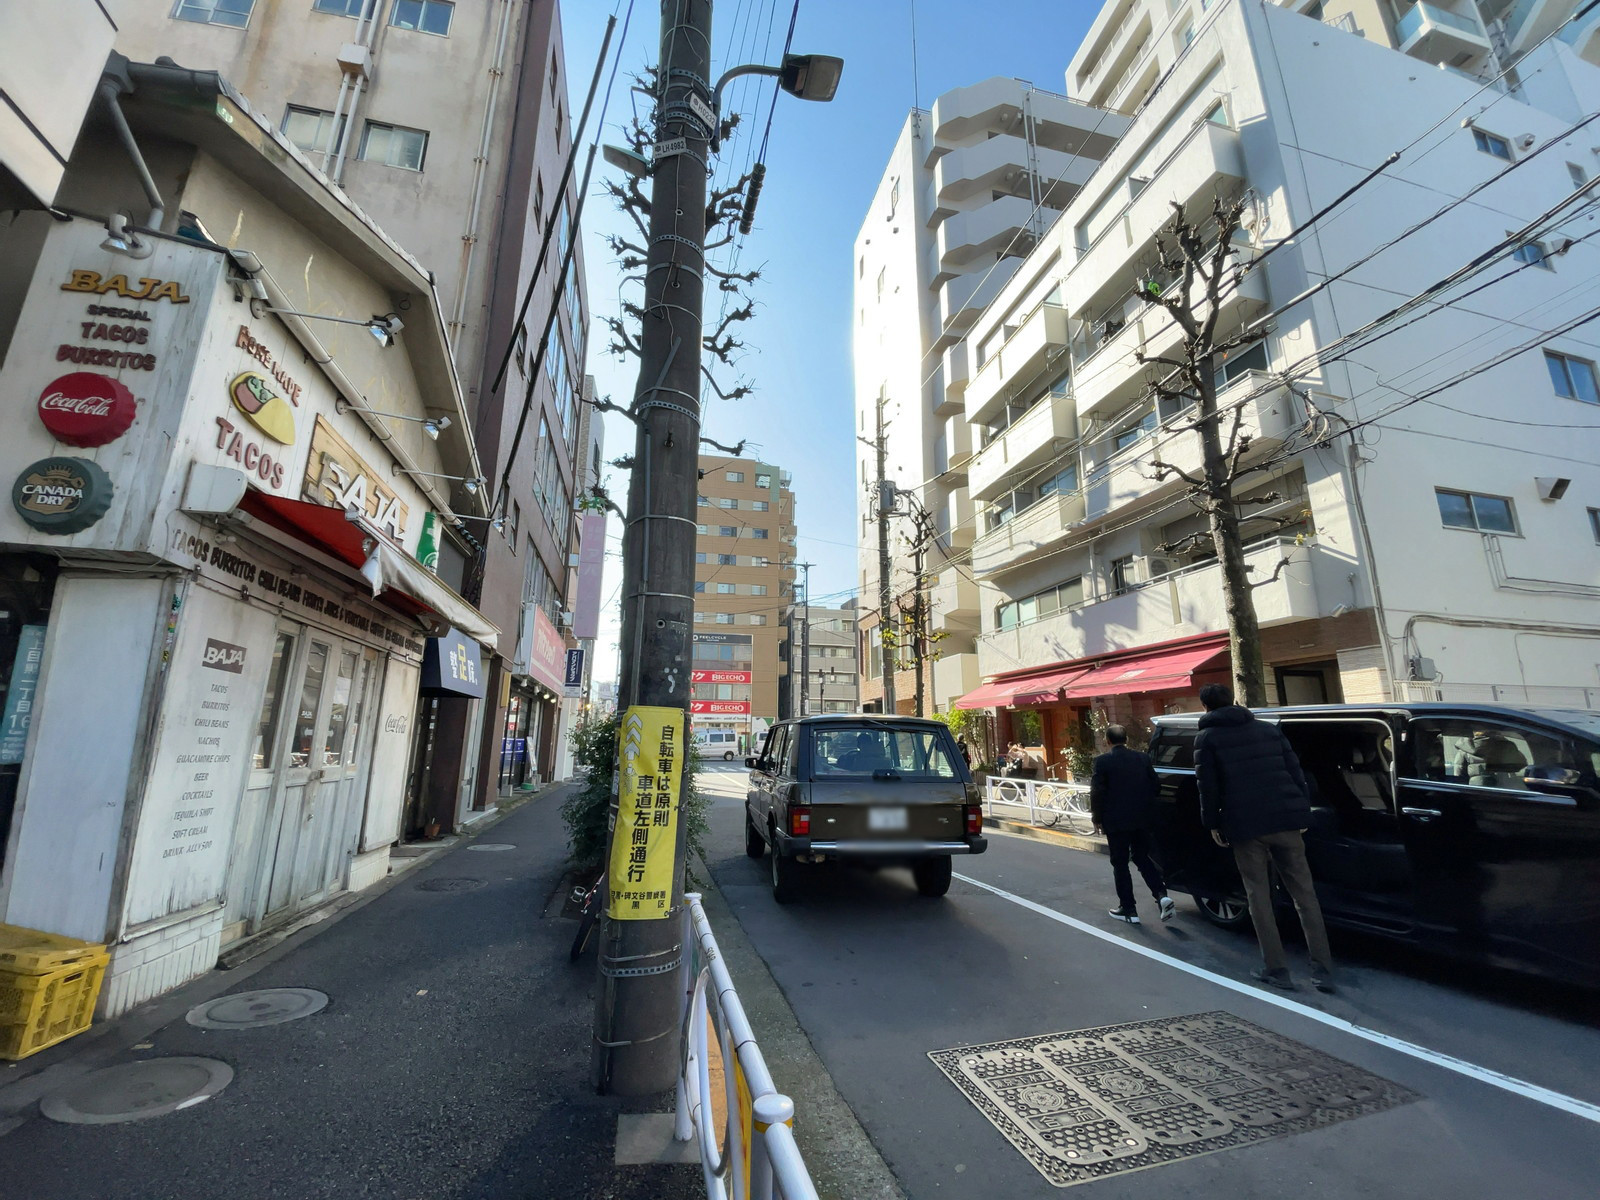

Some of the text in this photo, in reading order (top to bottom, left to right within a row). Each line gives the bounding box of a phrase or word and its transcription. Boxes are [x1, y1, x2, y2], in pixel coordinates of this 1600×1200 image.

[61, 269, 190, 304] BAJA
[86, 304, 152, 322] SPECIAL
[80, 321, 149, 345] TACOS
[55, 344, 156, 371] BURRITOS
[235, 325, 303, 408] HOME MADE
[216, 416, 285, 489] TACOS
[22, 484, 84, 499] CANADA
[302, 451, 405, 546] BAJA
[36, 495, 66, 506] DRY
[172, 528, 210, 563] TACOS
[209, 546, 257, 583] BURRITOS
[200, 646, 246, 666] BAJA
[210, 683, 229, 694] TACOS
[201, 700, 230, 711] BURRITOS
[210, 719, 230, 729] BEANS
[198, 736, 220, 747] NACHOS
[213, 754, 231, 763] CHIPS
[193, 772, 210, 782] BEER
[652, 724, 676, 828] 自転車は原則
[182, 789, 214, 801] COCKTAILS
[173, 809, 200, 822] TEQUILA
[171, 828, 188, 840] SOFT
[626, 774, 654, 883] 車道左側通行
[162, 846, 185, 859] DRINK
